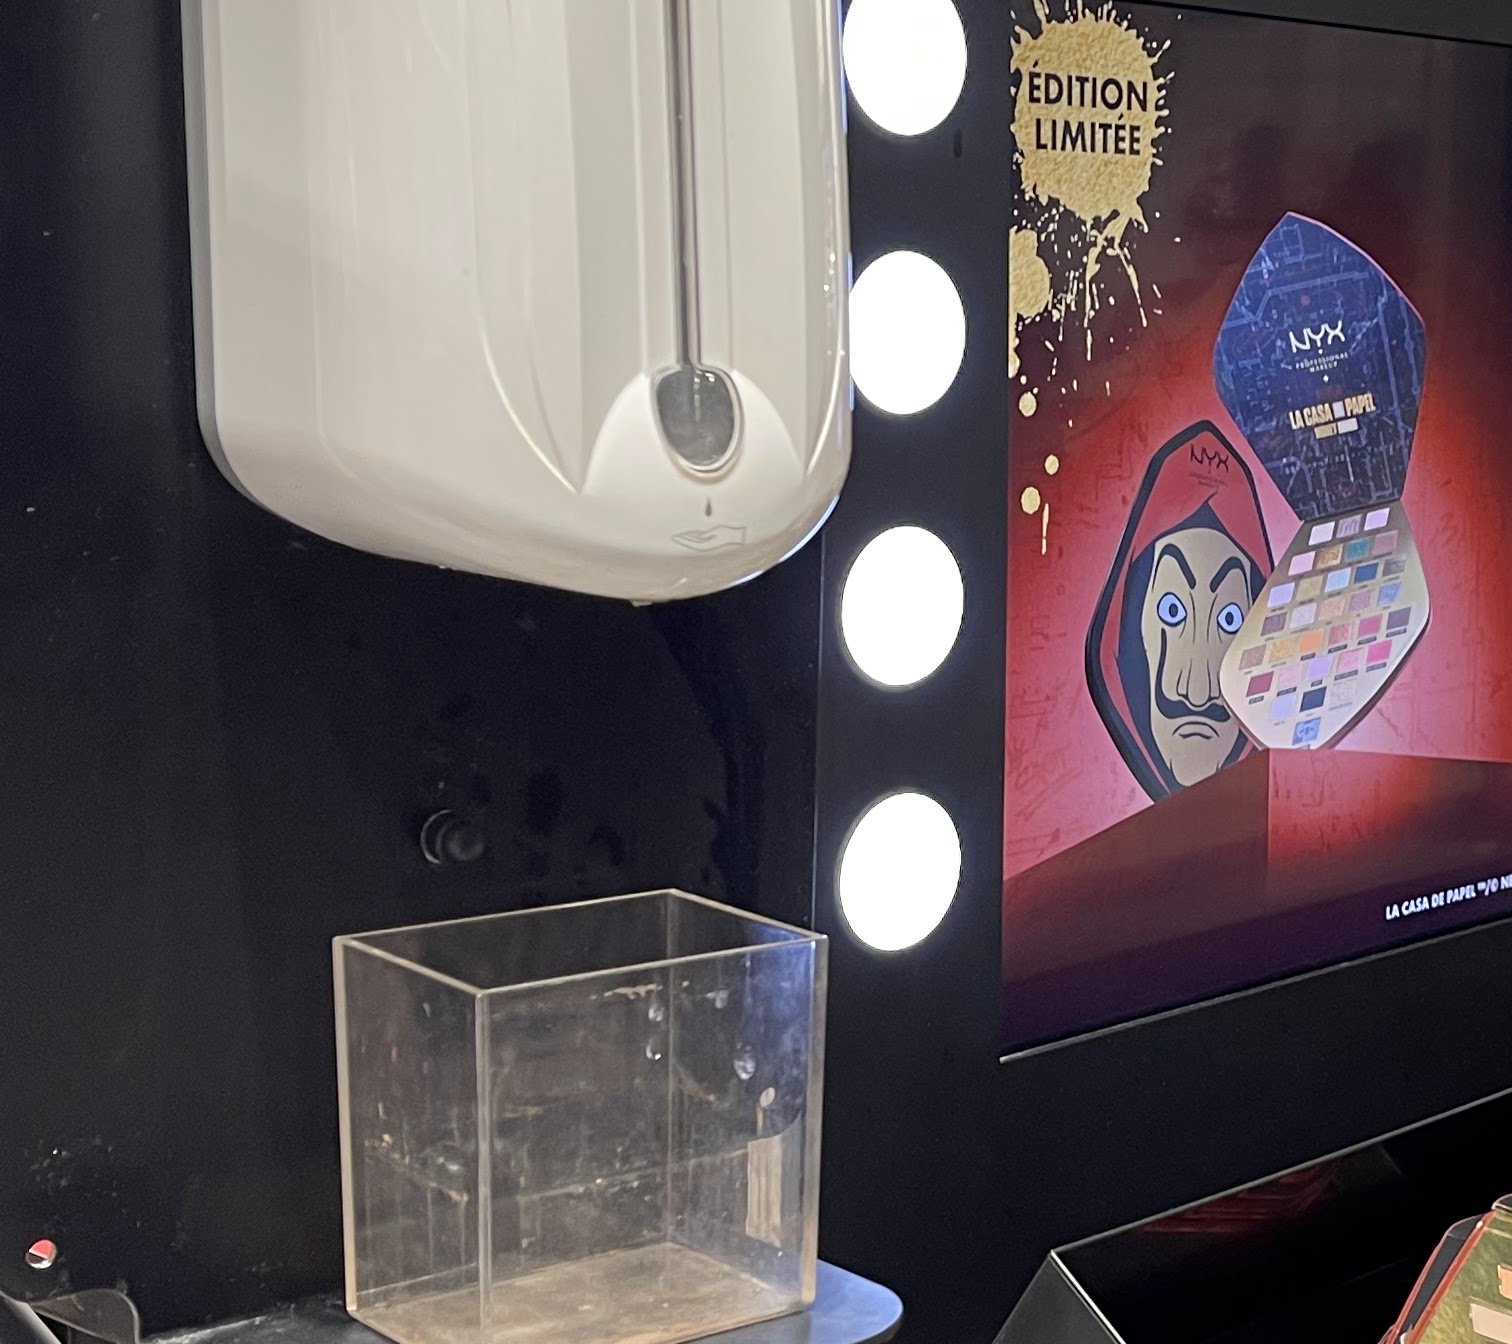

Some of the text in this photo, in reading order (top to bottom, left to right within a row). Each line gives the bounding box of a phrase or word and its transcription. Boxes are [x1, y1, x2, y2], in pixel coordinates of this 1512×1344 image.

[1028, 59, 1148, 112] ÉDITION
[1035, 112, 1141, 156] LIMITÉE
[1289, 320, 1346, 353] NYX
[1288, 409, 1305, 430] LA
[1303, 402, 1333, 427] CASA
[1344, 392, 1377, 417] PAPEL
[1190, 443, 1229, 473] NYX
[1385, 903, 1400, 920] LA
[1401, 896, 1430, 916] CASA
[1431, 892, 1445, 909] DE
[1446, 884, 1477, 904] PAPEL
